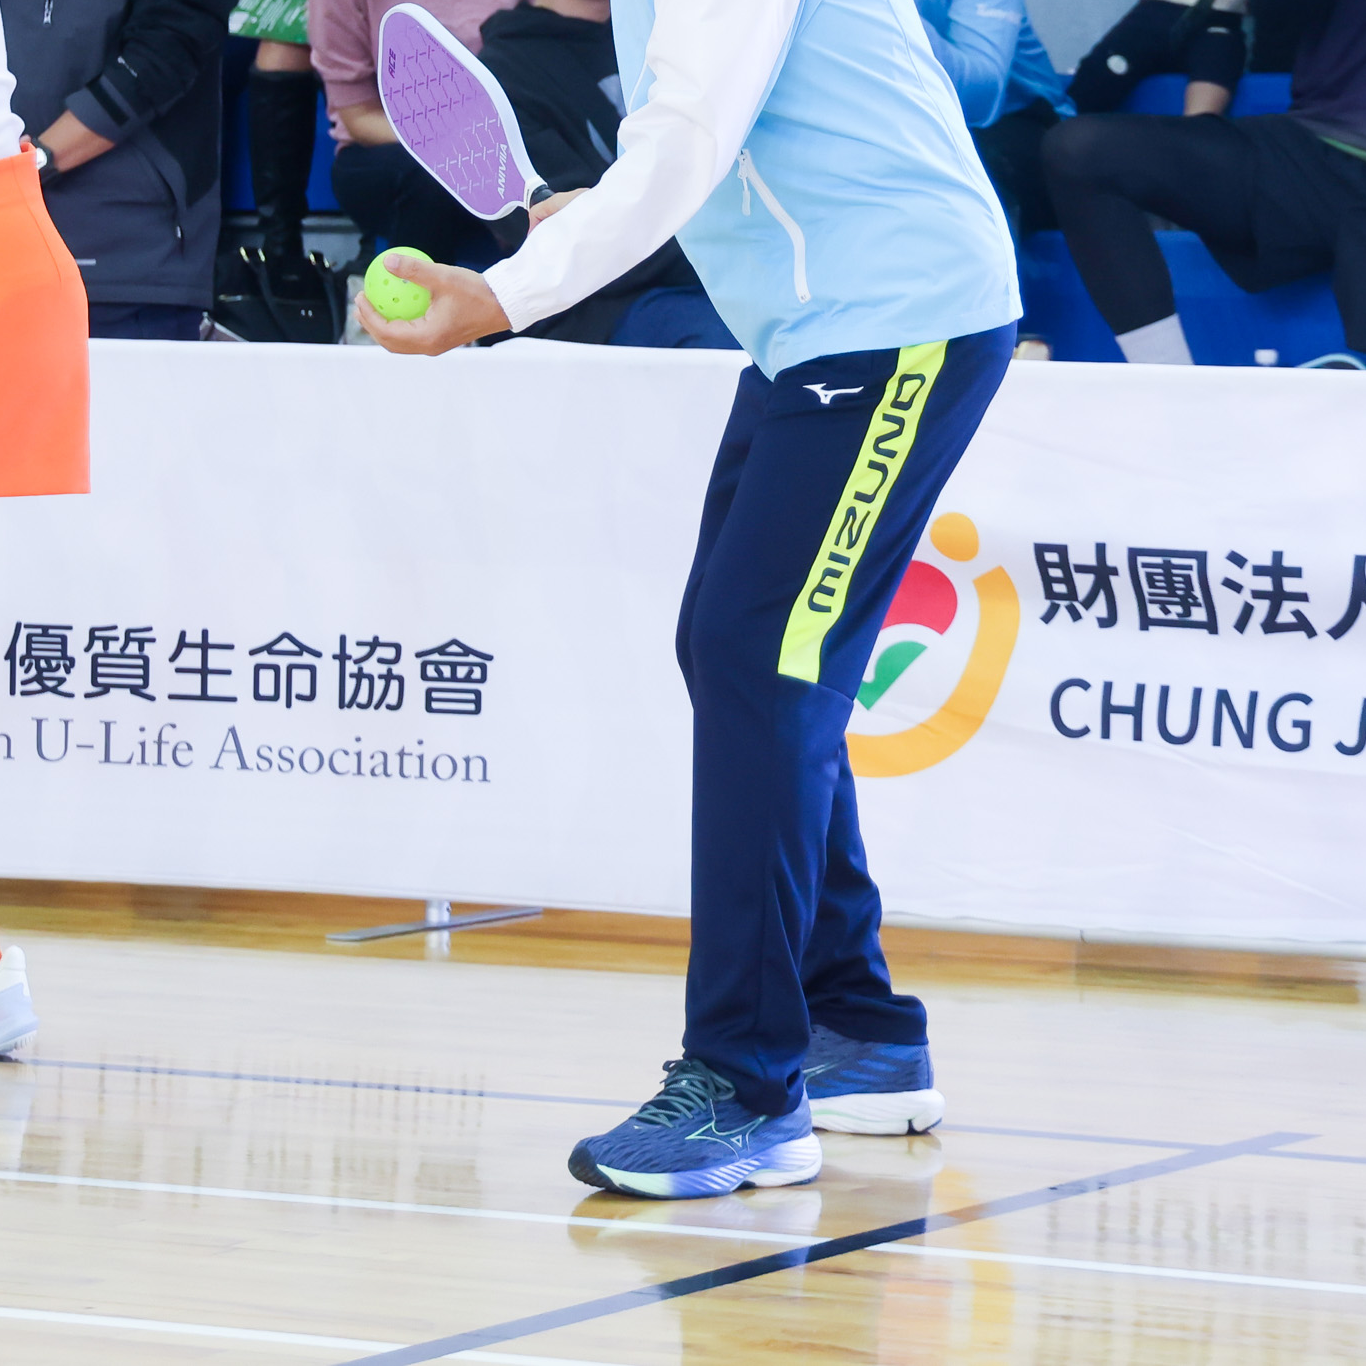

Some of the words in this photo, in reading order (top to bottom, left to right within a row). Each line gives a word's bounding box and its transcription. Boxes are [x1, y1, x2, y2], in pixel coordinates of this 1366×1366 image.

[388, 48, 397, 79] ACE
[807, 373, 926, 613] MIZUNO
[30, 717, 194, 768] U-Life
[209, 725, 491, 783] Association
[1050, 678, 1314, 753] CHUNG
